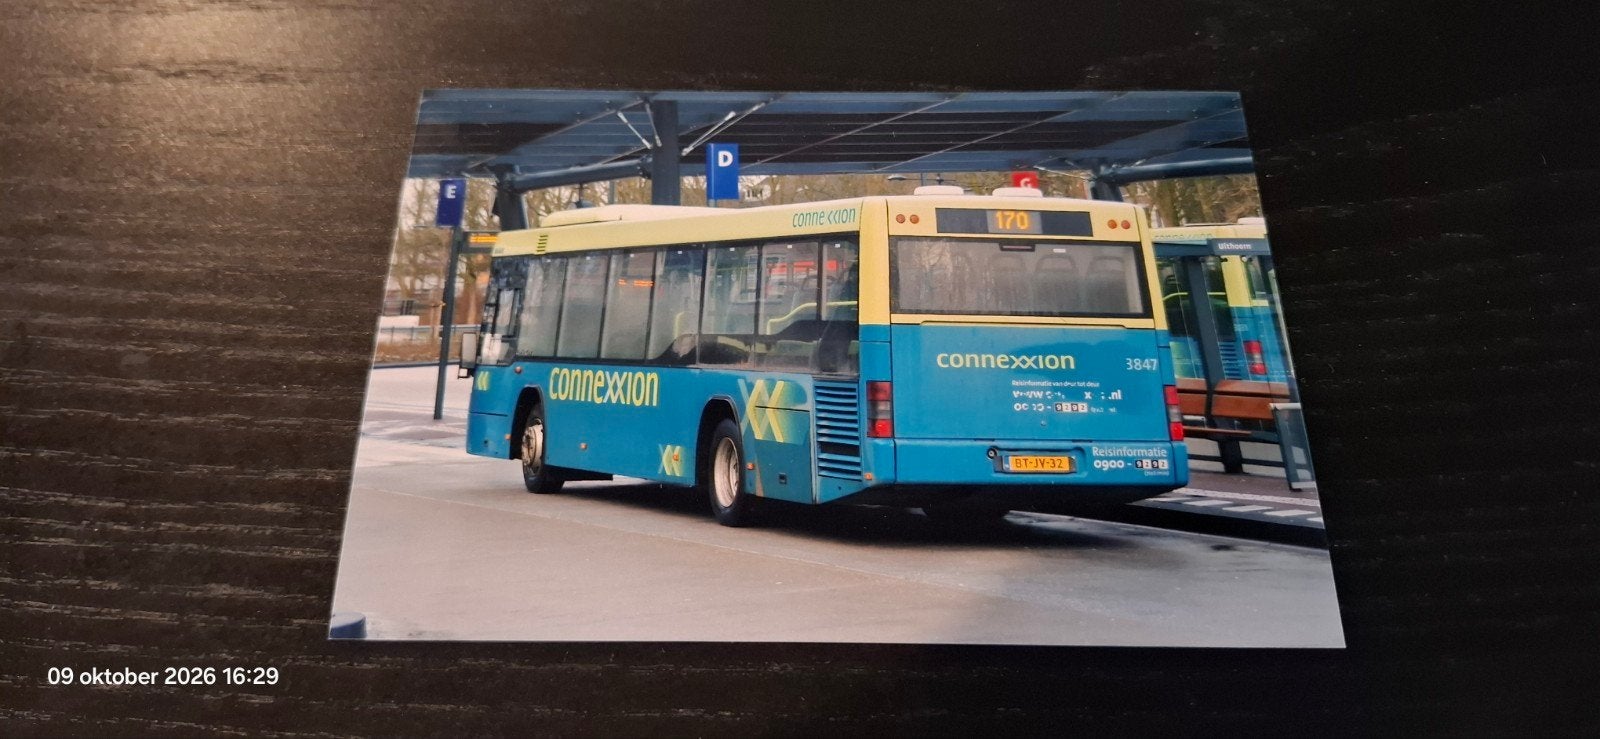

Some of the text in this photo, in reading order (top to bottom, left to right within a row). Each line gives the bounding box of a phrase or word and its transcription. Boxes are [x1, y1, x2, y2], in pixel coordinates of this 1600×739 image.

[718, 150, 734, 167] D
[445, 185, 457, 199] E
[996, 210, 1029, 230] 170
[937, 353, 1075, 370] connexxion
[1126, 358, 1158, 371] 3847
[549, 367, 660, 407] connexxion
[1055, 402, 1088, 412] 9292
[1092, 447, 1167, 457] Reisinformatie
[1015, 458, 1063, 469] BT-JV-32
[1094, 460, 1125, 471] 0900
[1135, 459, 1168, 469] 9292
